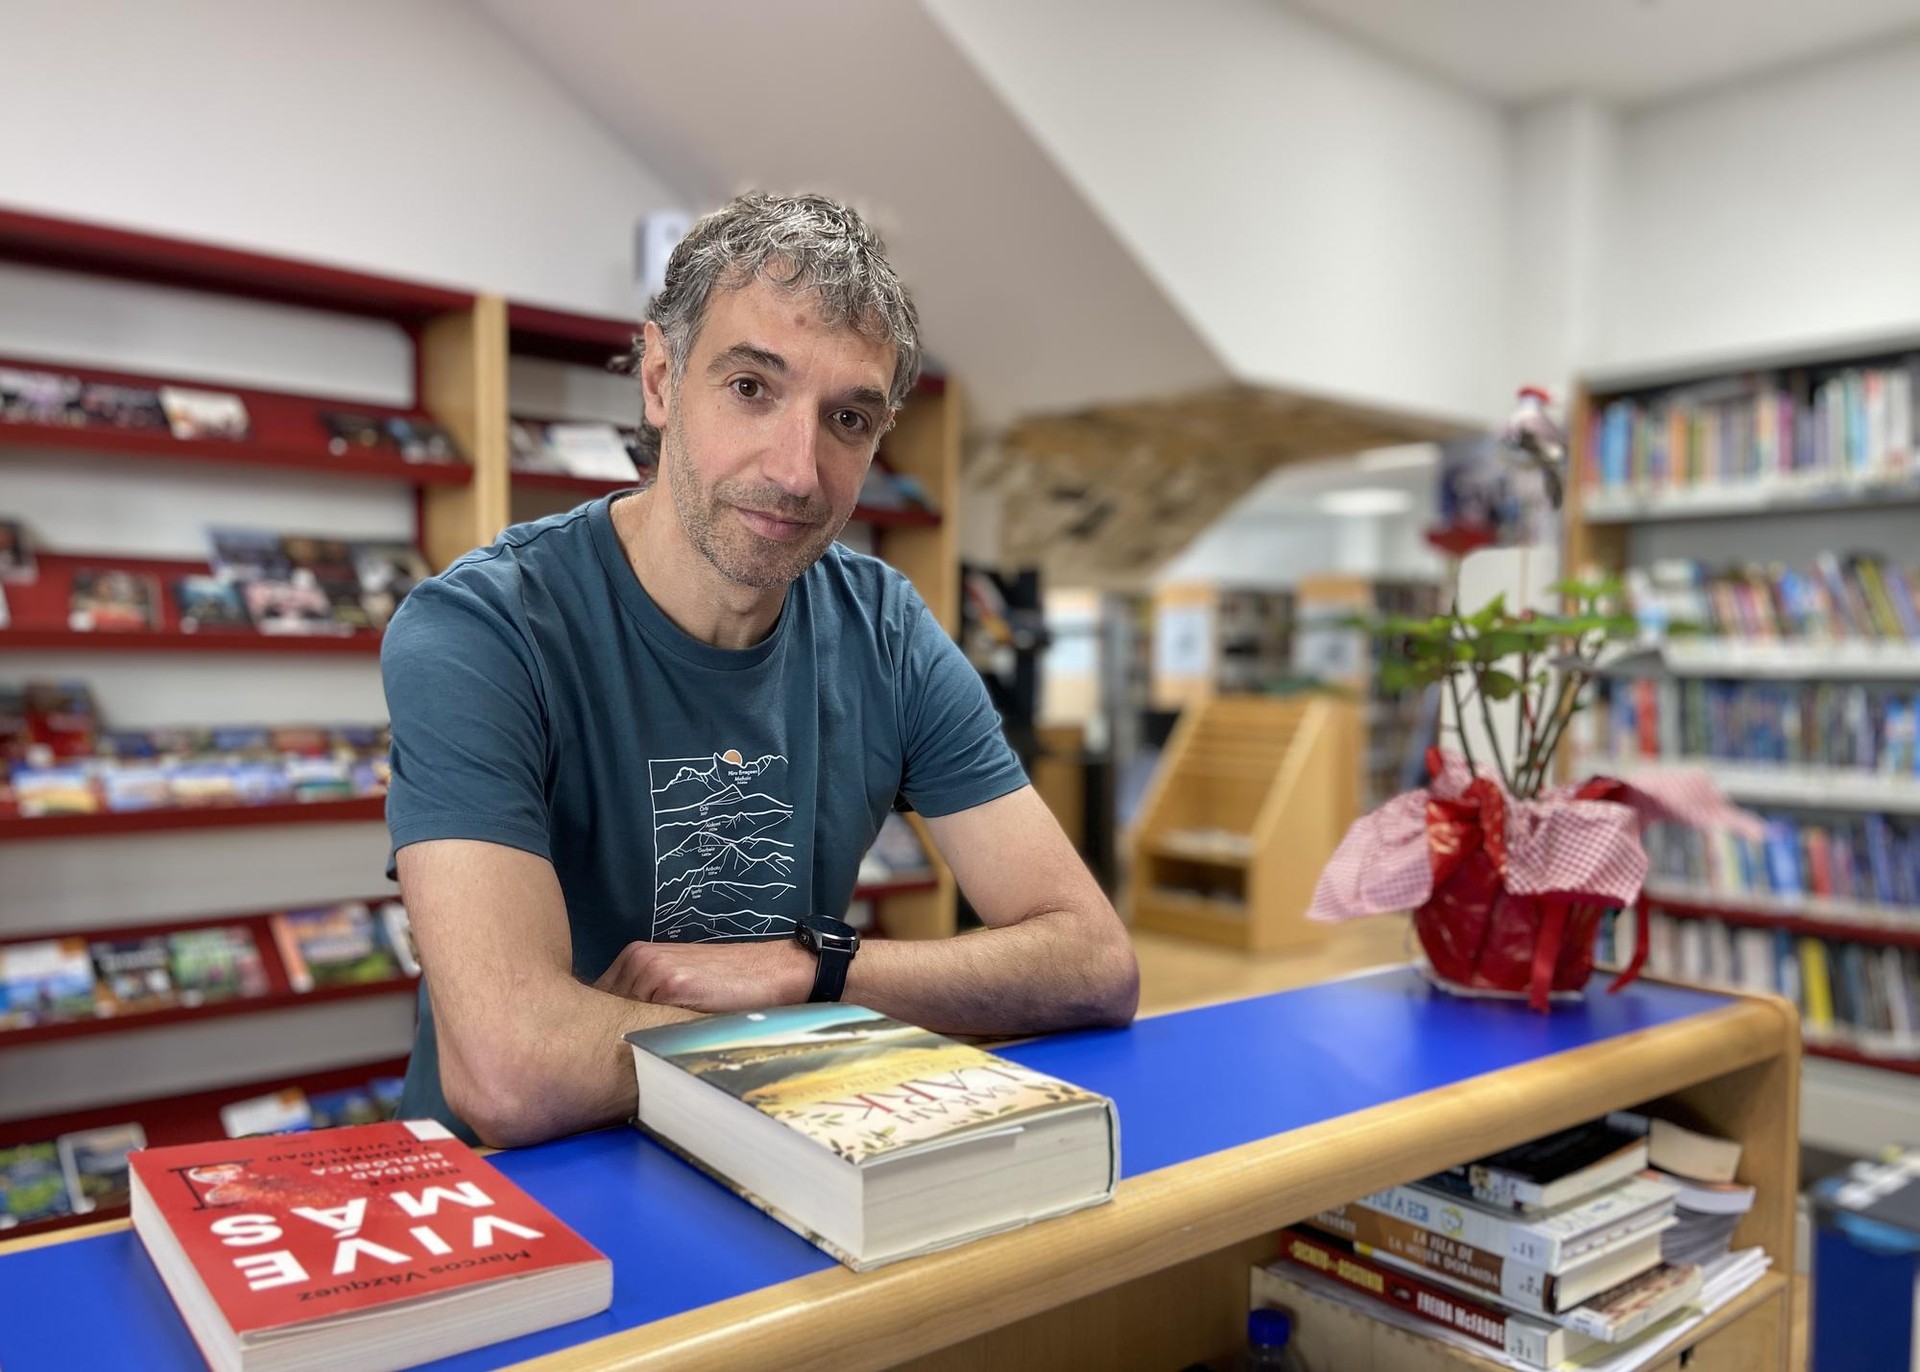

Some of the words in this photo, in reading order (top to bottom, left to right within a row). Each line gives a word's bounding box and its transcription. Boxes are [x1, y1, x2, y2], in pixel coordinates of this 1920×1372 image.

[819, 1066, 1021, 1120] LARK
[893, 1084, 1018, 1125] SARAH
[266, 1143, 391, 1162] VITALIDAD
[300, 1147, 412, 1168] AUMENTA
[423, 1160, 455, 1171] TU
[350, 1164, 416, 1181] EDAD
[367, 1167, 462, 1188] REDUCE
[210, 1181, 496, 1247] MÁS
[1413, 1229, 1427, 1243] LA
[232, 1215, 545, 1292] VIVE
[429, 1250, 533, 1276] Marcos
[298, 1270, 427, 1301] Vázquez
[1454, 1305, 1504, 1344] McFADDE
